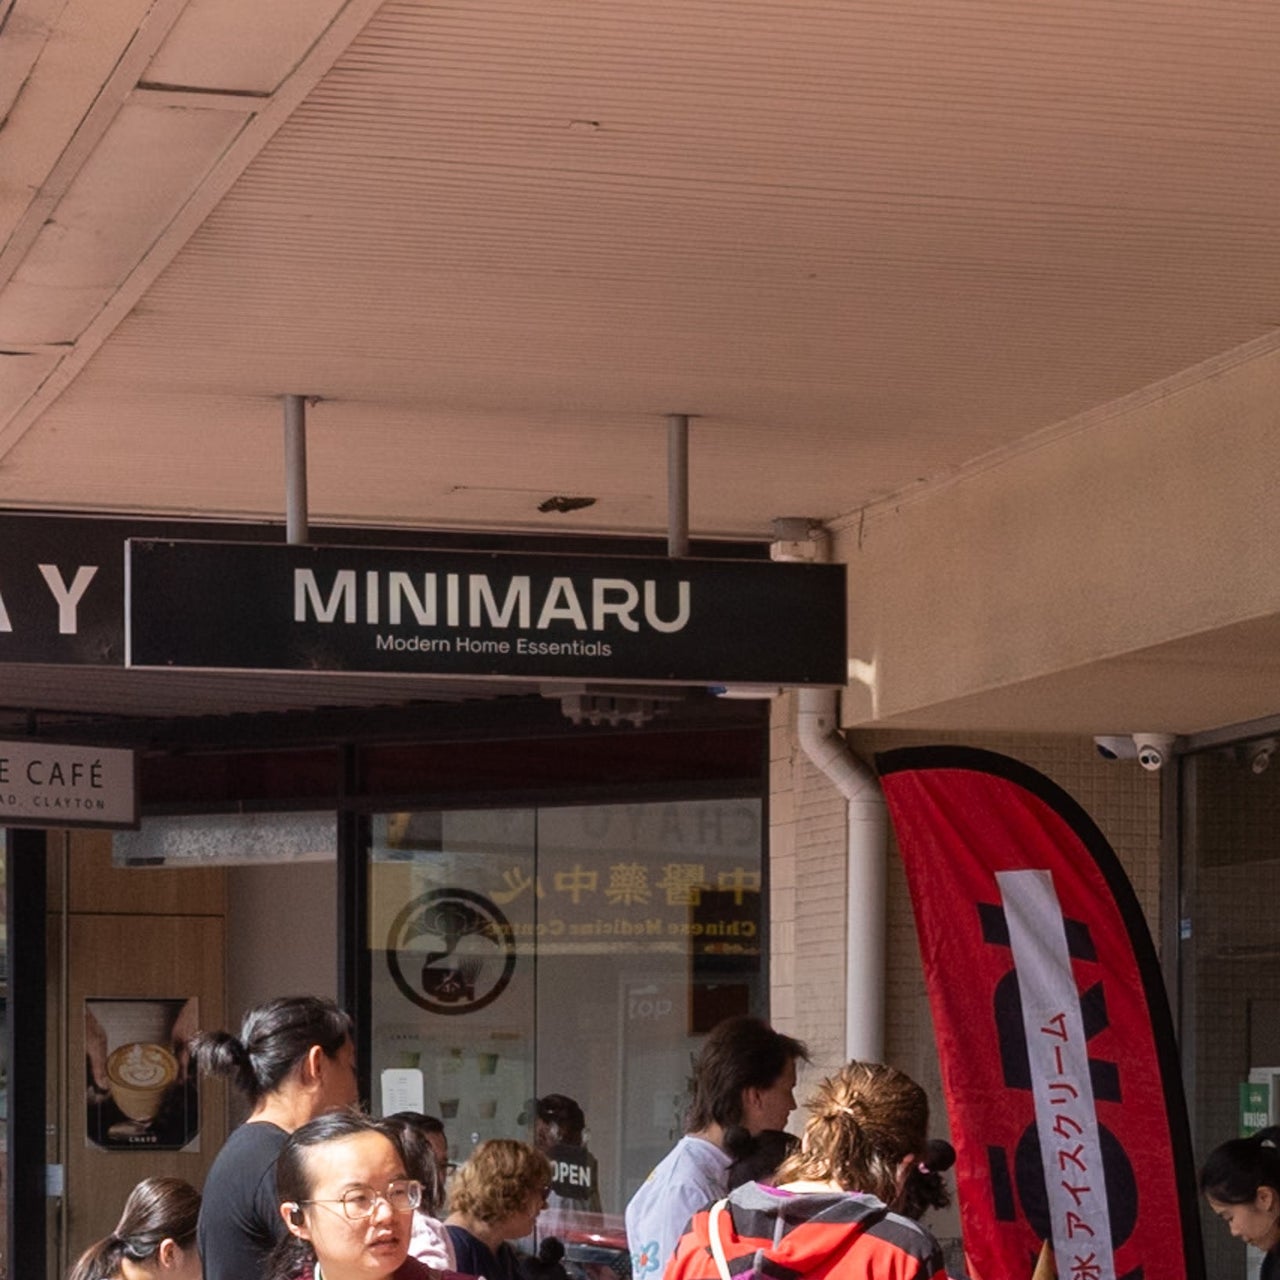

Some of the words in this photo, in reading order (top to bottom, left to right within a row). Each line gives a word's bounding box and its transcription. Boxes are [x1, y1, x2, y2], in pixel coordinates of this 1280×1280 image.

[293, 568, 692, 634] MINIMARU
[375, 634, 451, 655] Modern
[455, 637, 511, 655] Home
[515, 638, 612, 658] Essentials
[27, 759, 102, 788] CAFÉ
[33, 796, 104, 809] CLAYTON
